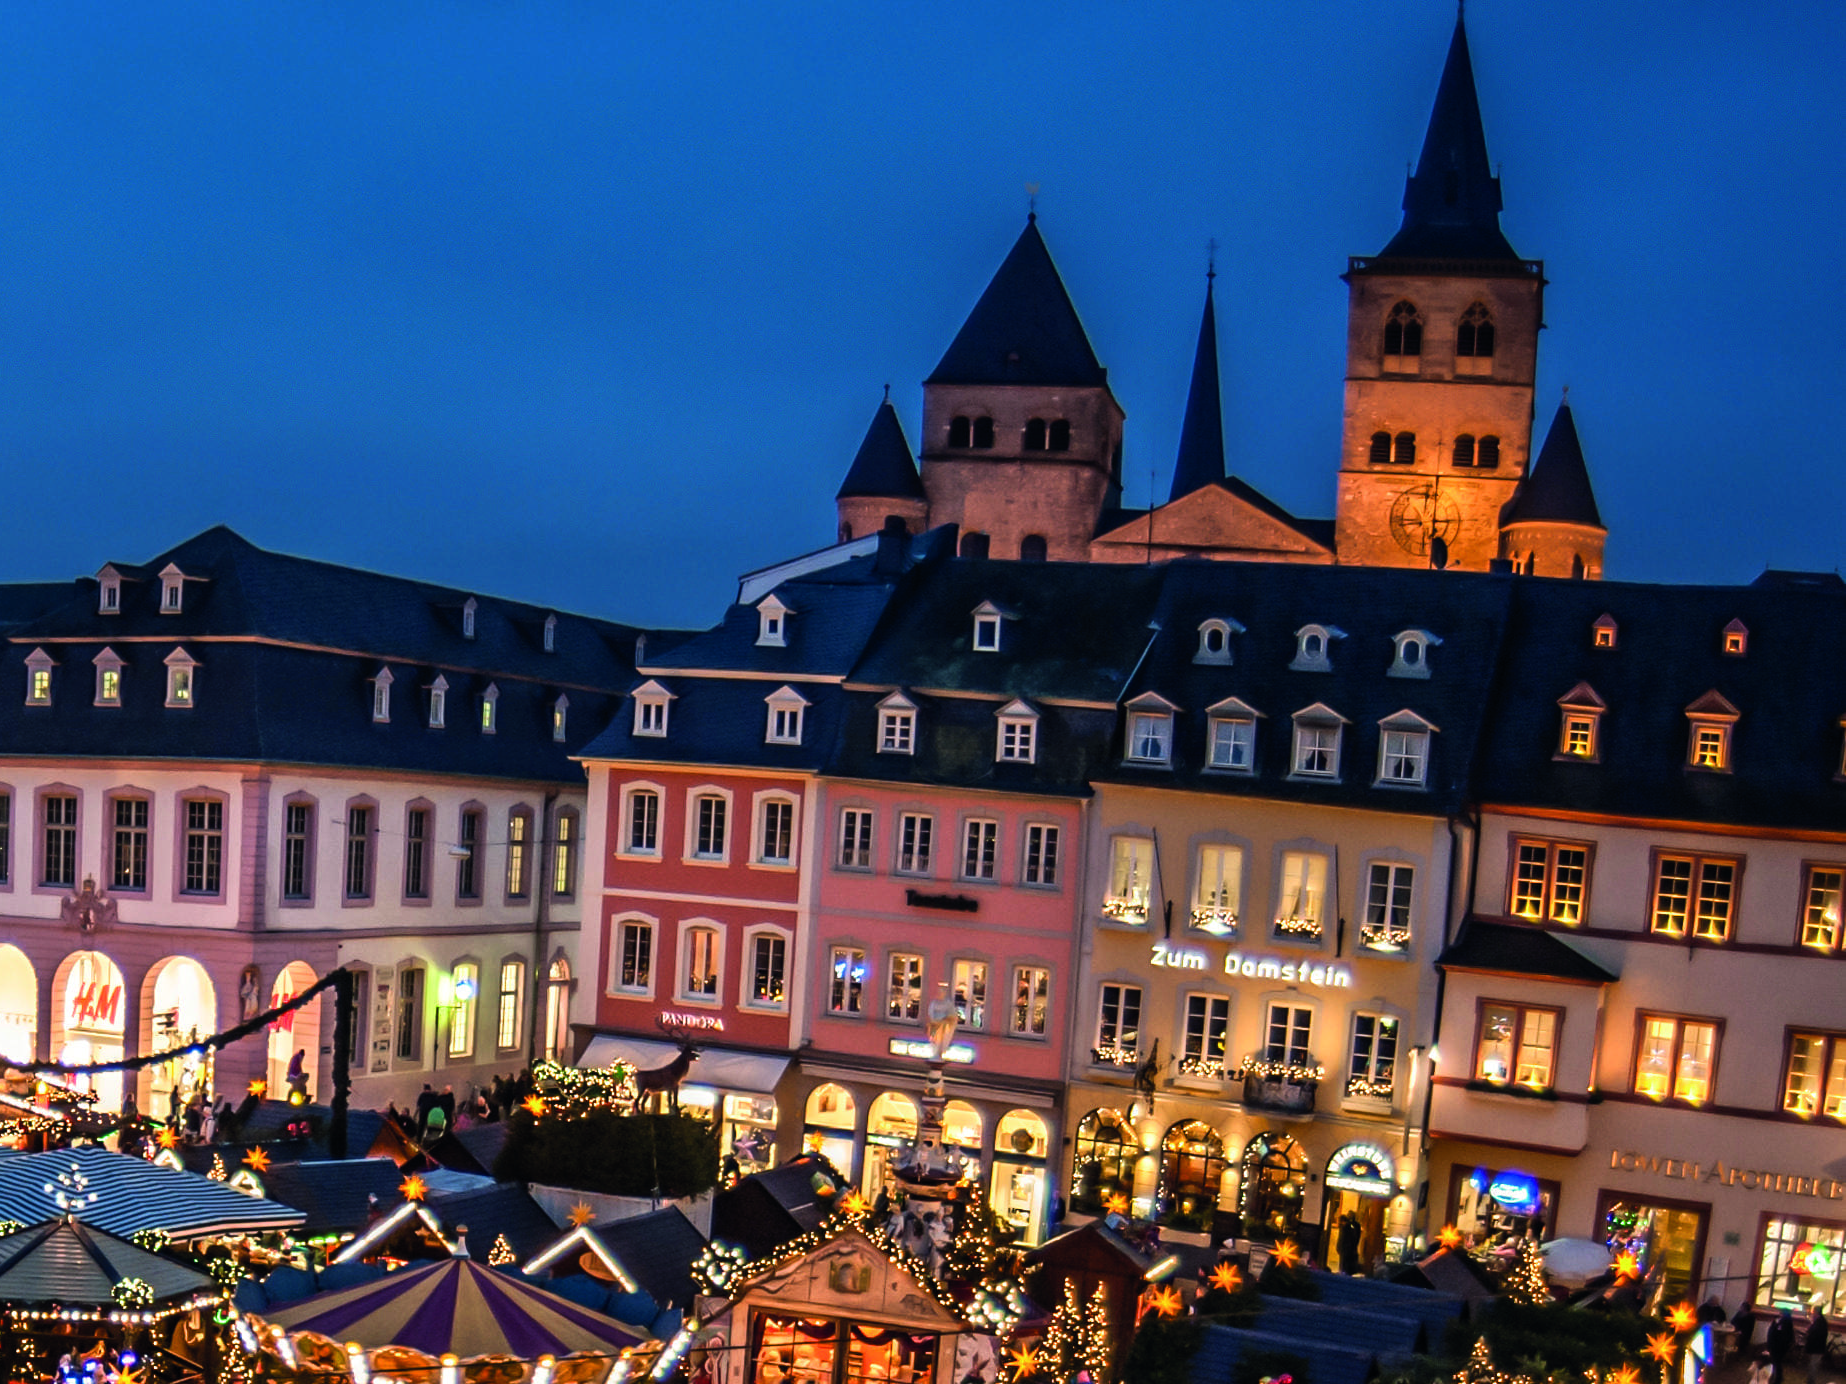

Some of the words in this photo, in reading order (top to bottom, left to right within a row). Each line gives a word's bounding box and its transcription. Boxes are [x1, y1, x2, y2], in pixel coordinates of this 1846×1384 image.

[1150, 945, 1207, 971] Zum
[1224, 953, 1350, 988] Domstein
[71, 981, 122, 1025] H&M
[660, 1010, 725, 1033] PANDORA
